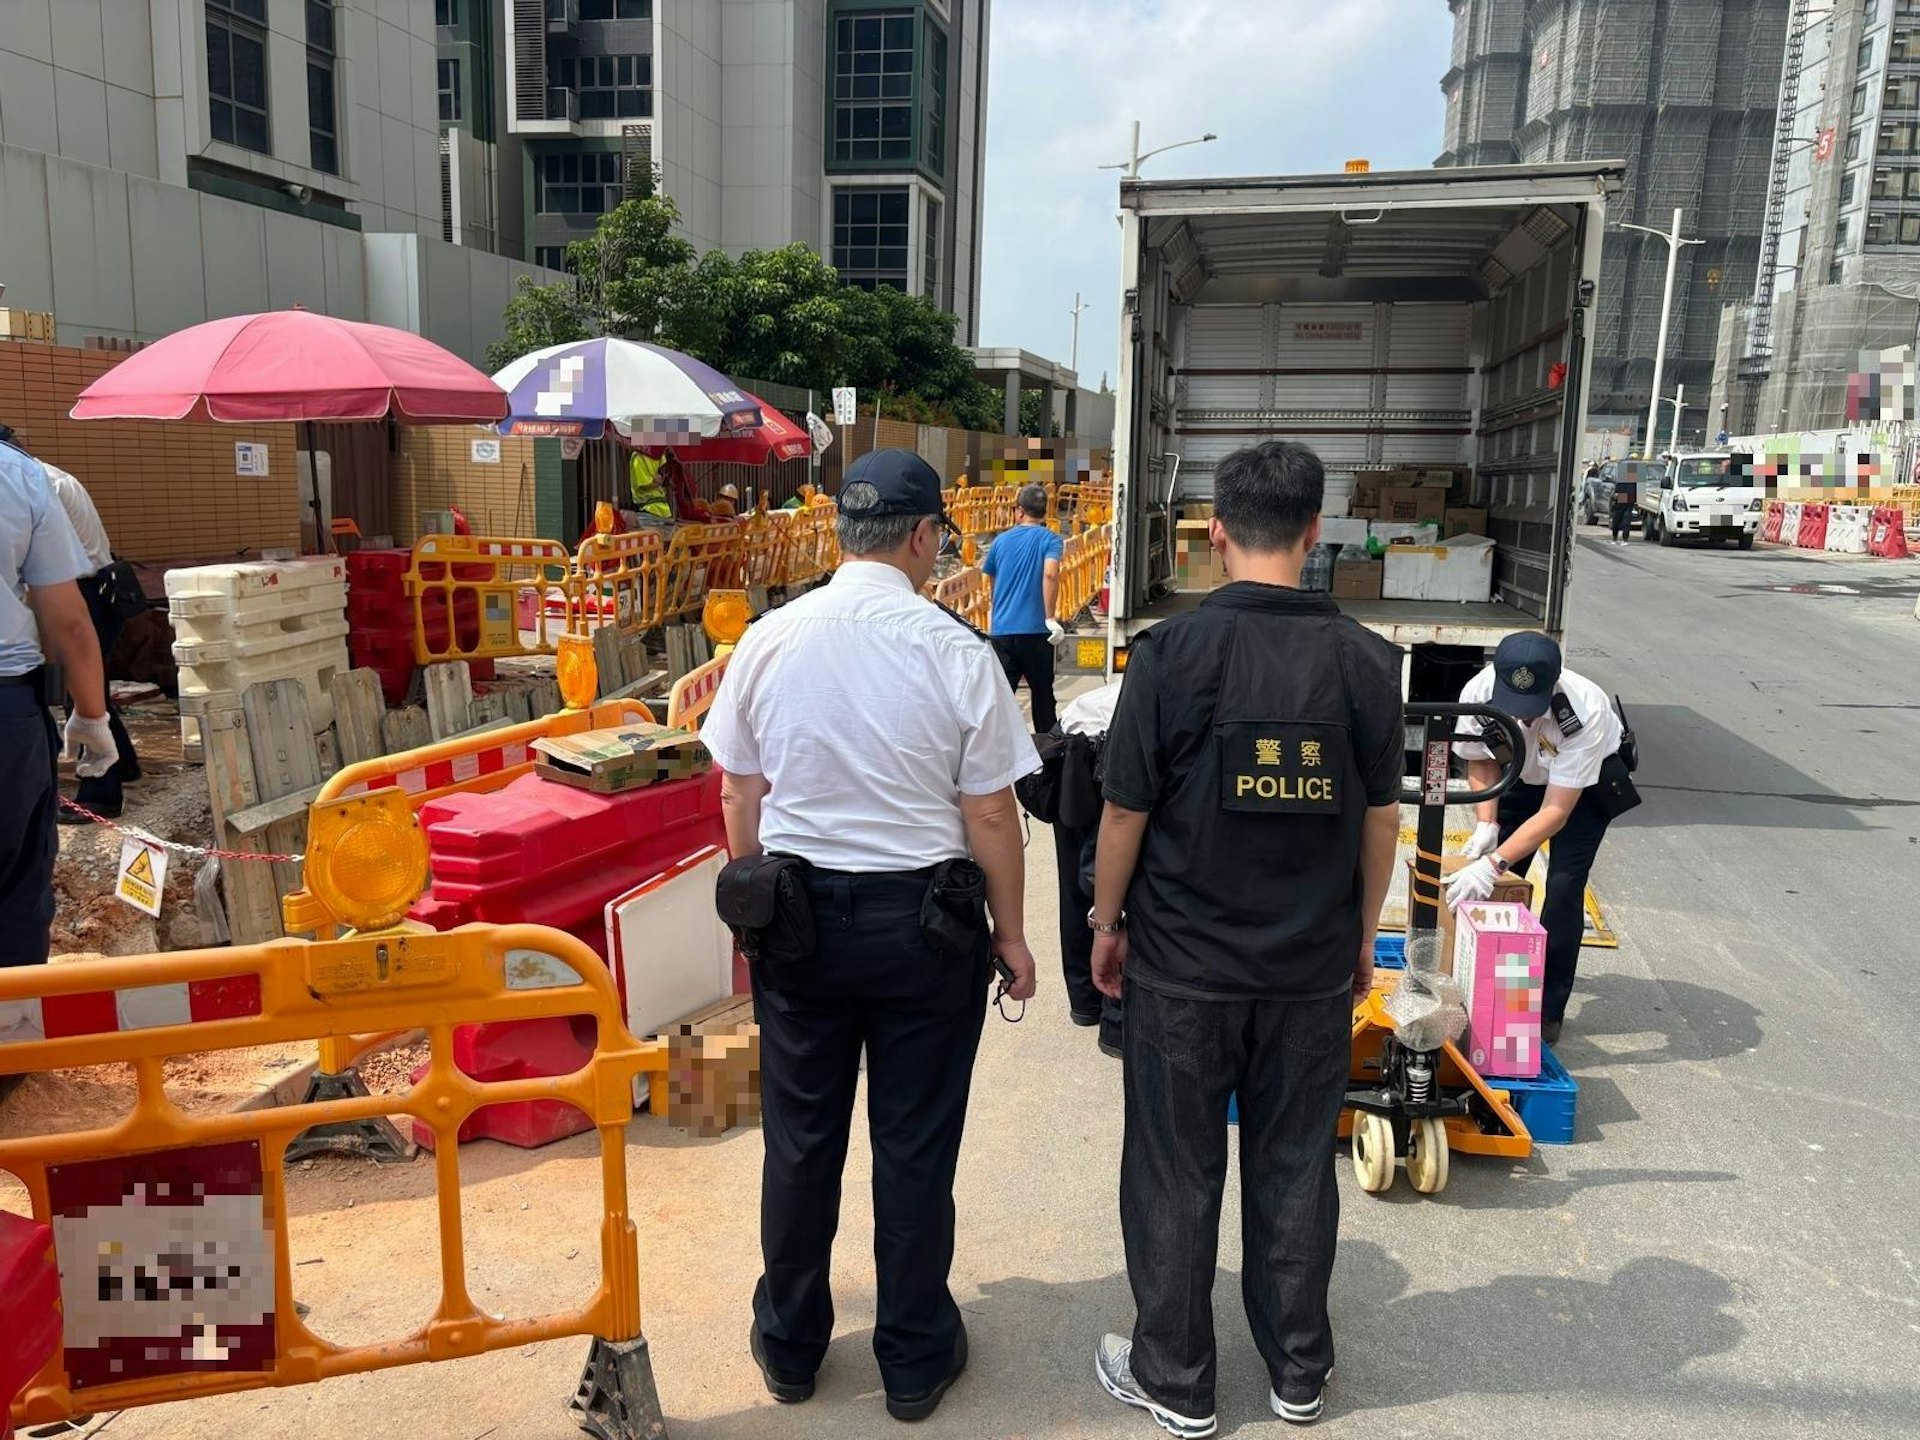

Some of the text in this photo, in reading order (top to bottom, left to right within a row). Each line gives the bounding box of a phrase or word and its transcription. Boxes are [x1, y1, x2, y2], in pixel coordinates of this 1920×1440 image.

[1819, 133, 1831, 155] 5
[1255, 739, 1321, 766] 警察
[1236, 775, 1332, 800] POLICE
